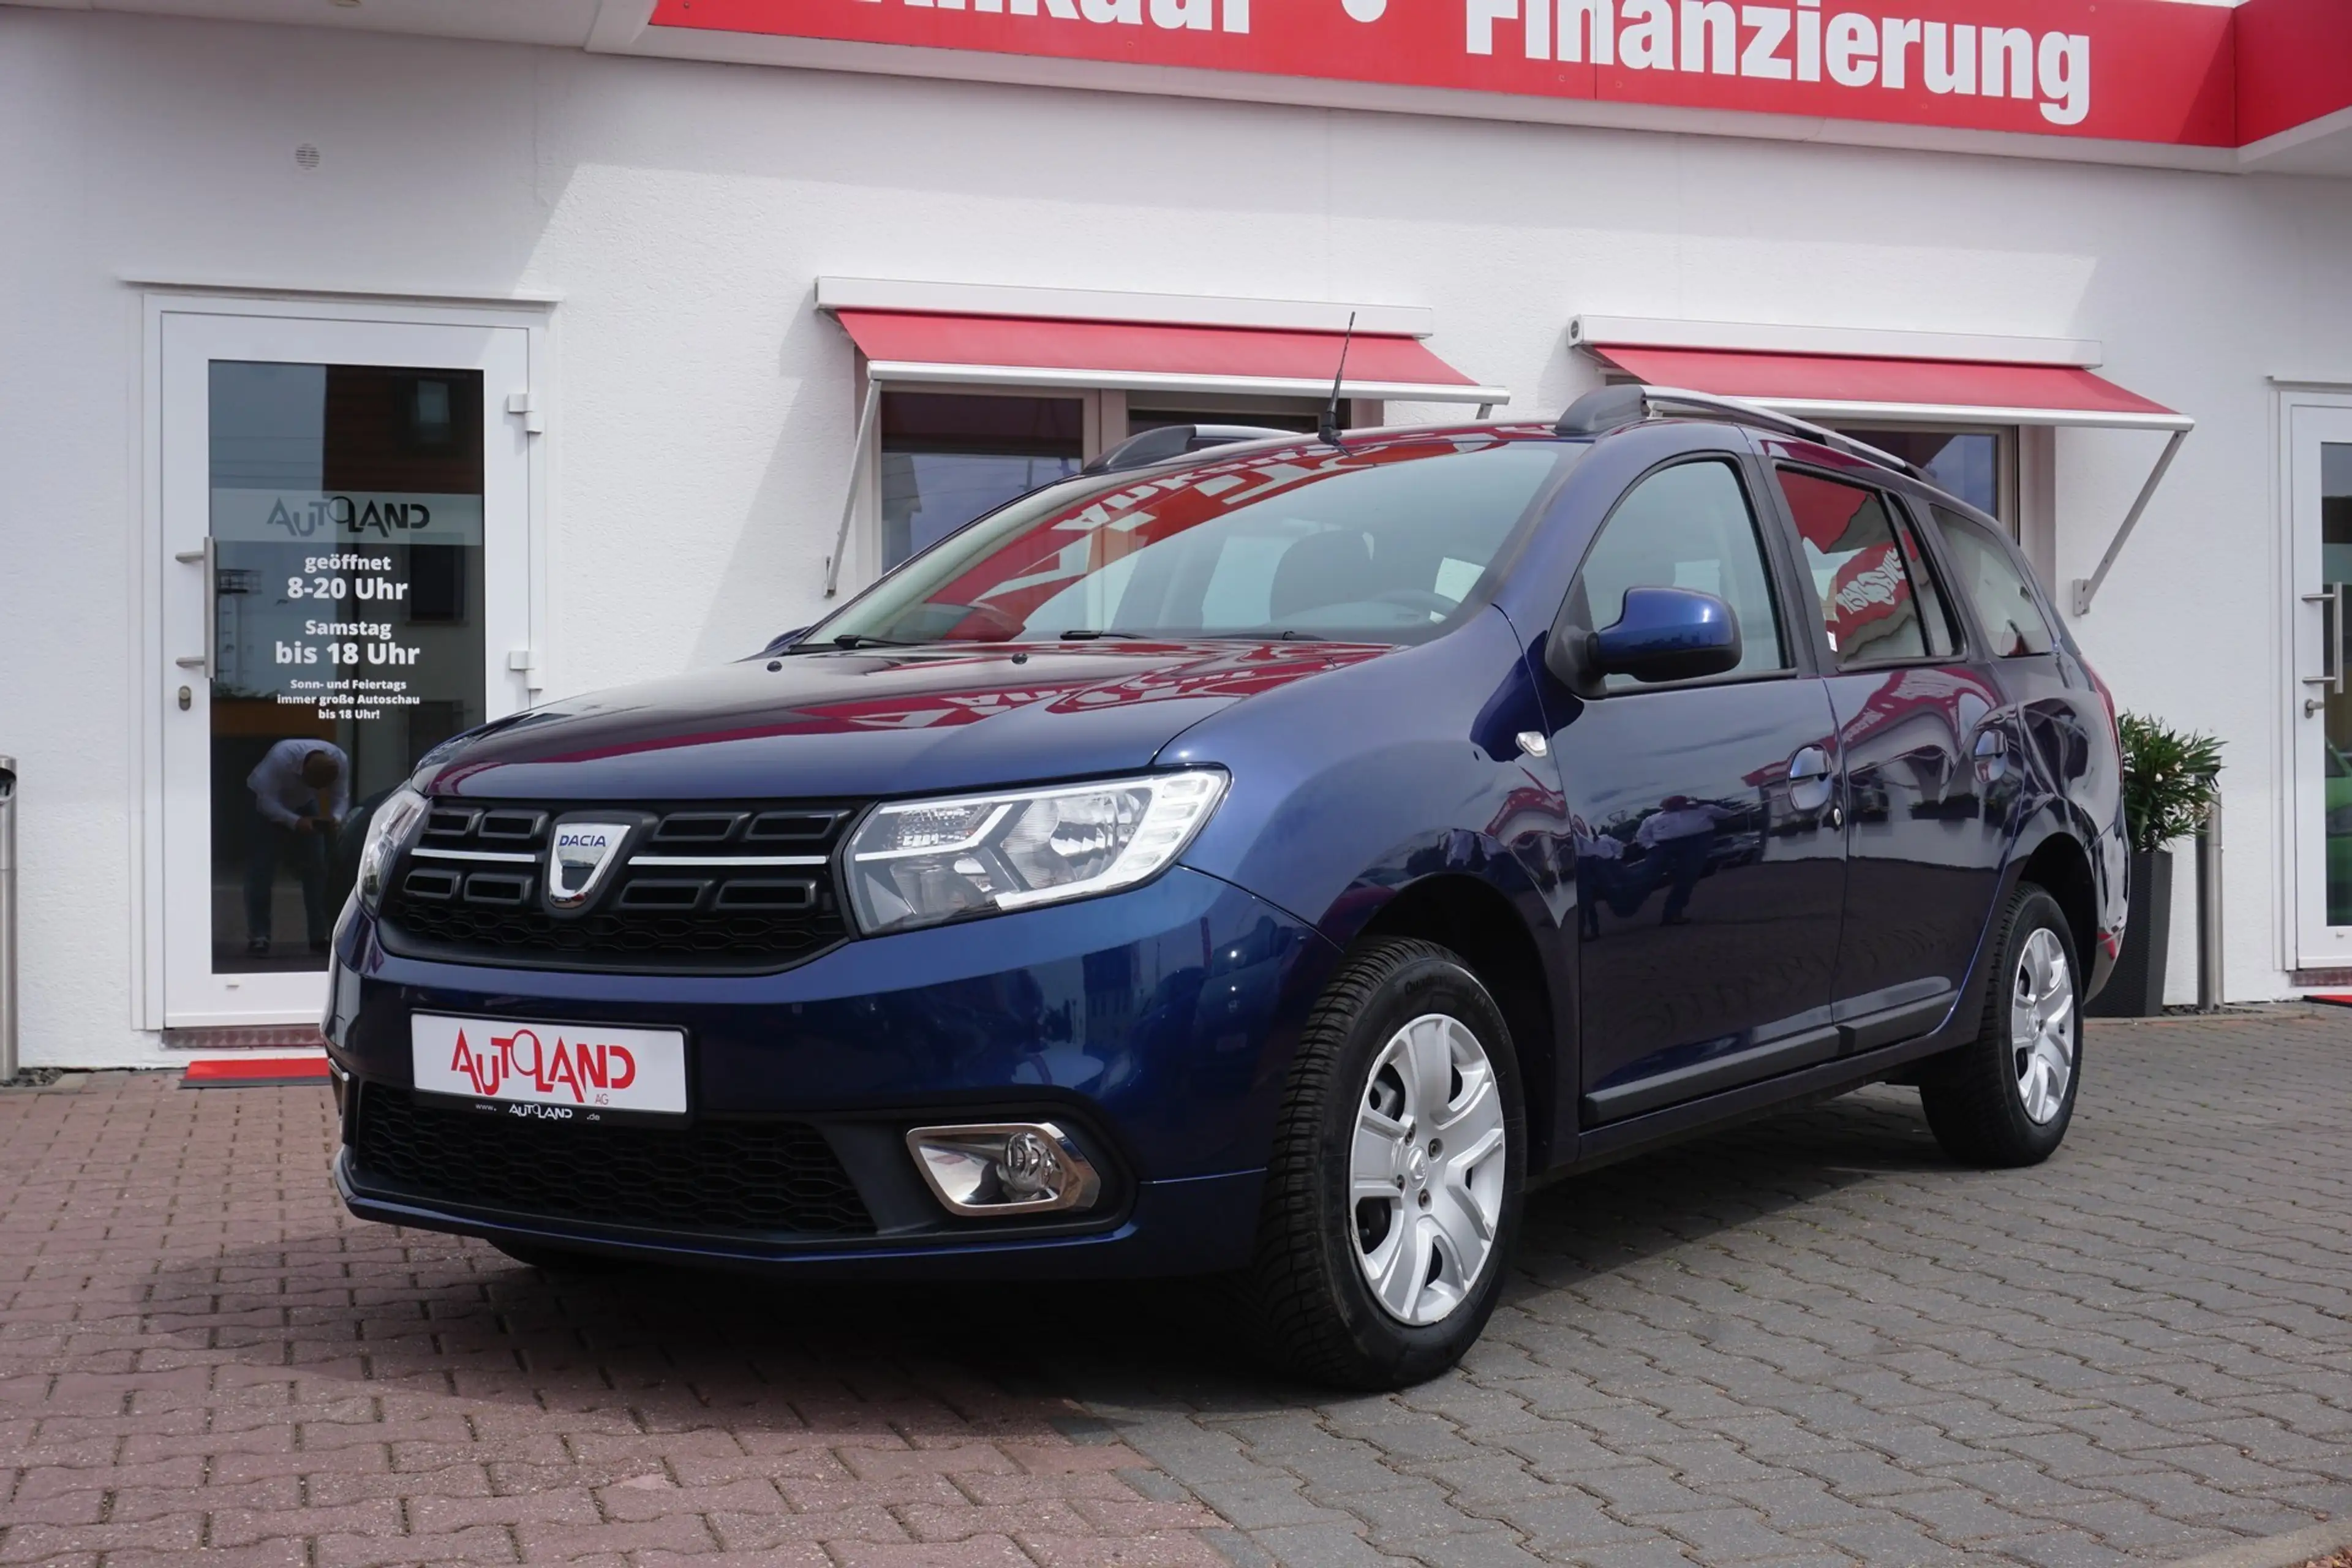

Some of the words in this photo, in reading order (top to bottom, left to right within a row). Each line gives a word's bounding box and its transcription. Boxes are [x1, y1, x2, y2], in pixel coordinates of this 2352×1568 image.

[1466, 0, 2090, 124] Finanzierung
[304, 554, 391, 573] geöffnet
[288, 577, 346, 598] 8-20
[355, 578, 408, 600] Uhr
[305, 620, 391, 640] Samstag
[276, 641, 317, 664] bis
[326, 643, 359, 665] 18
[368, 642, 420, 665] Uhr
[290, 679, 324, 689] Sonn-
[326, 679, 349, 689] und
[352, 680, 407, 692] Feiertags
[277, 695, 316, 704] immer
[319, 695, 354, 706] große
[357, 695, 420, 704] Autoschau
[318, 709, 336, 719] bis
[339, 709, 352, 719] 18
[355, 709, 380, 719] Uhr!
[559, 835, 606, 846] DACIA
[595, 1093, 609, 1106] AG
